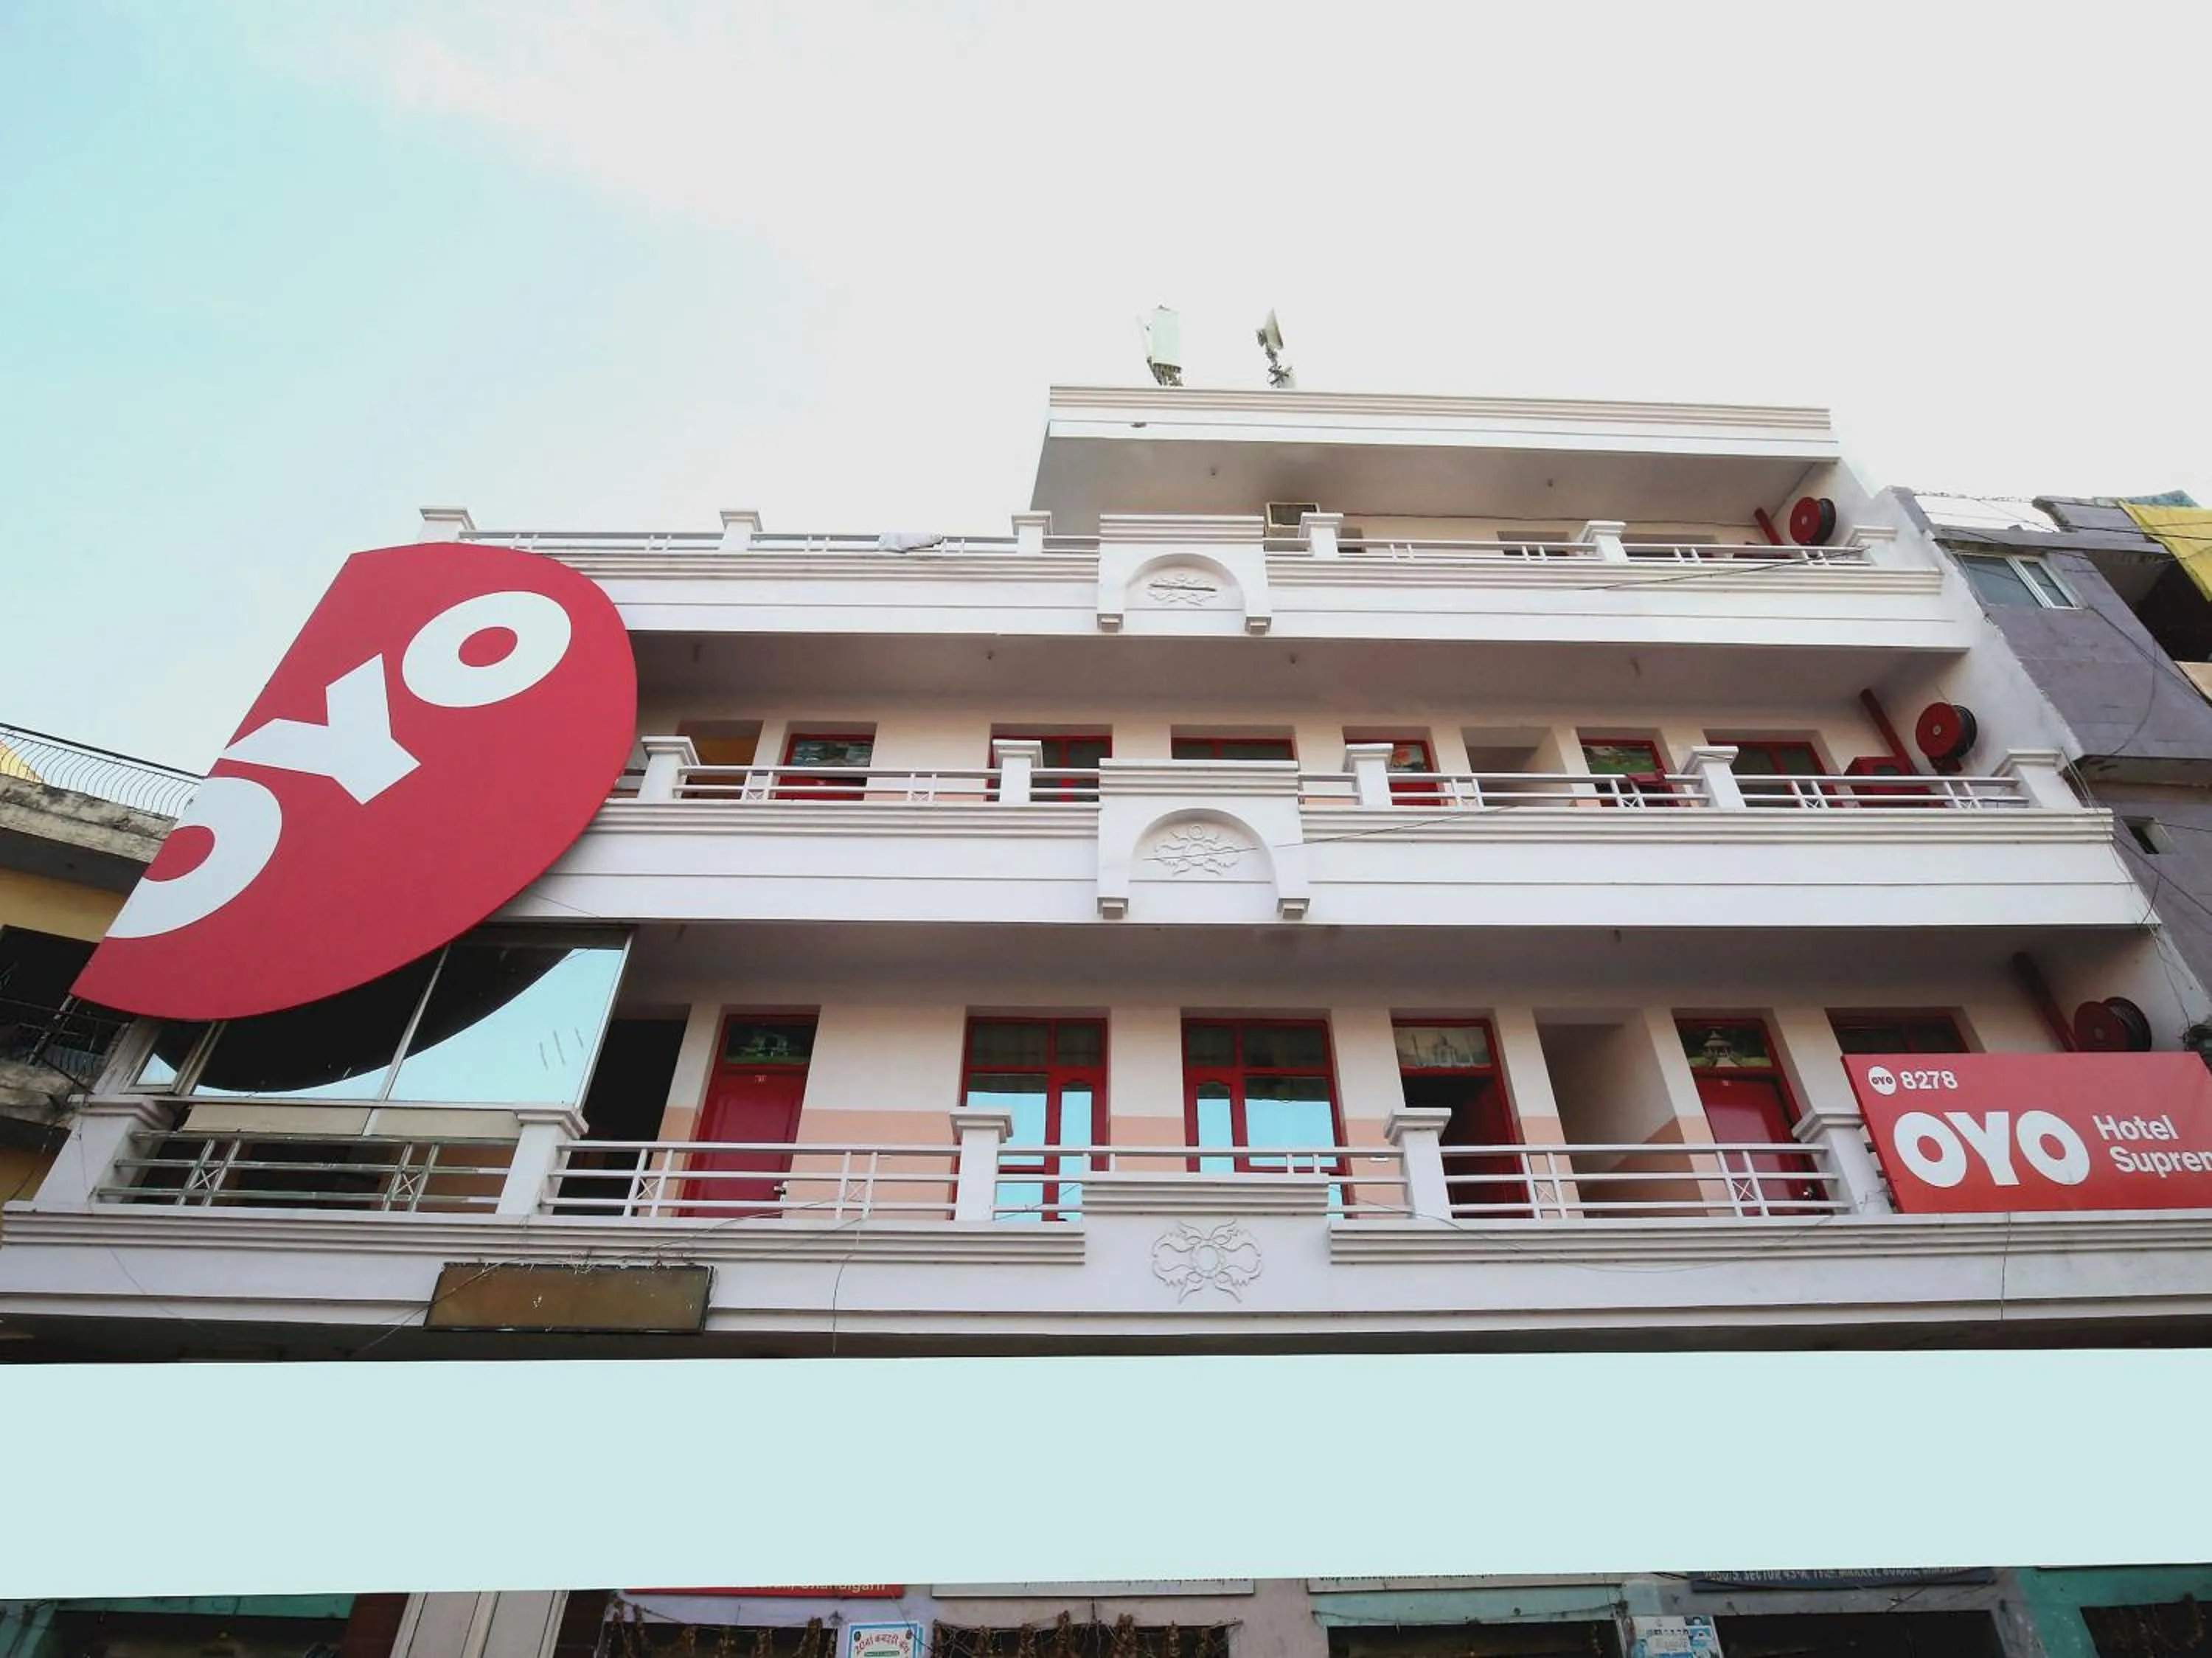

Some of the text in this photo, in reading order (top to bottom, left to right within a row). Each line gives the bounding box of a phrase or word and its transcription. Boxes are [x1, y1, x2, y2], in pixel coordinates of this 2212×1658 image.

[105, 591, 571, 939] OYO
[1871, 1070, 1958, 1090] OYO 8278
[1893, 1110, 2091, 1188] OYO
[2093, 1114, 2180, 1140] Hotel
